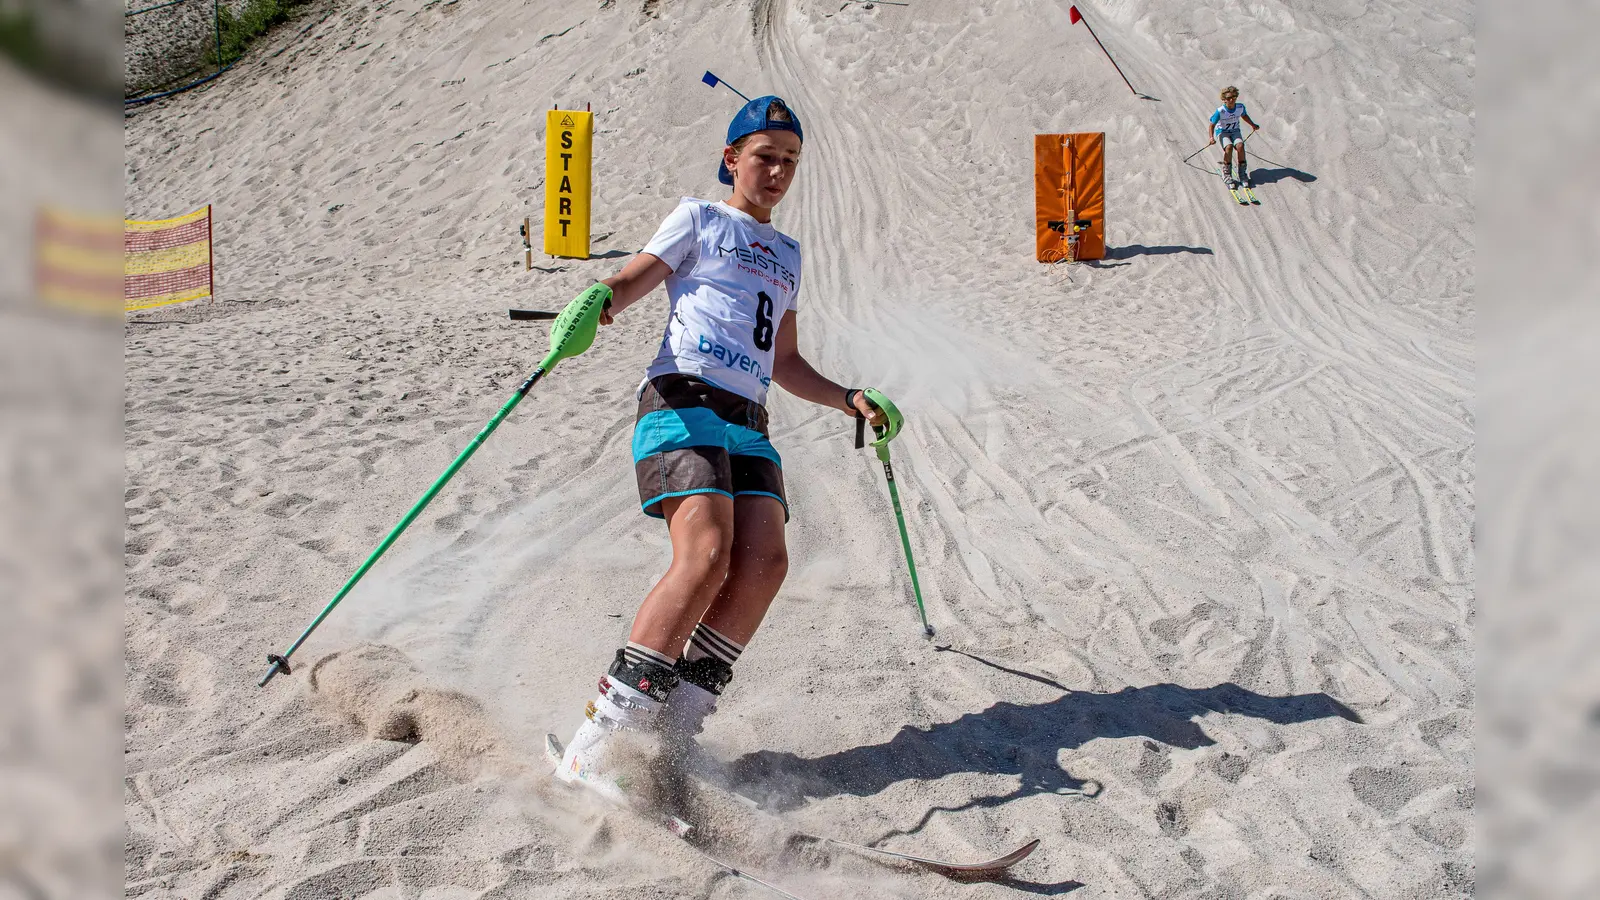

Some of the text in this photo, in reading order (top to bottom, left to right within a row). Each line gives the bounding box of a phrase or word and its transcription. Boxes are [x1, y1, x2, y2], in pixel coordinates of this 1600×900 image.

[559, 130, 572, 237] START
[717, 245, 796, 292] MEISTER
[556, 288, 602, 352] KOMPERDELL
[753, 290, 774, 353] 6
